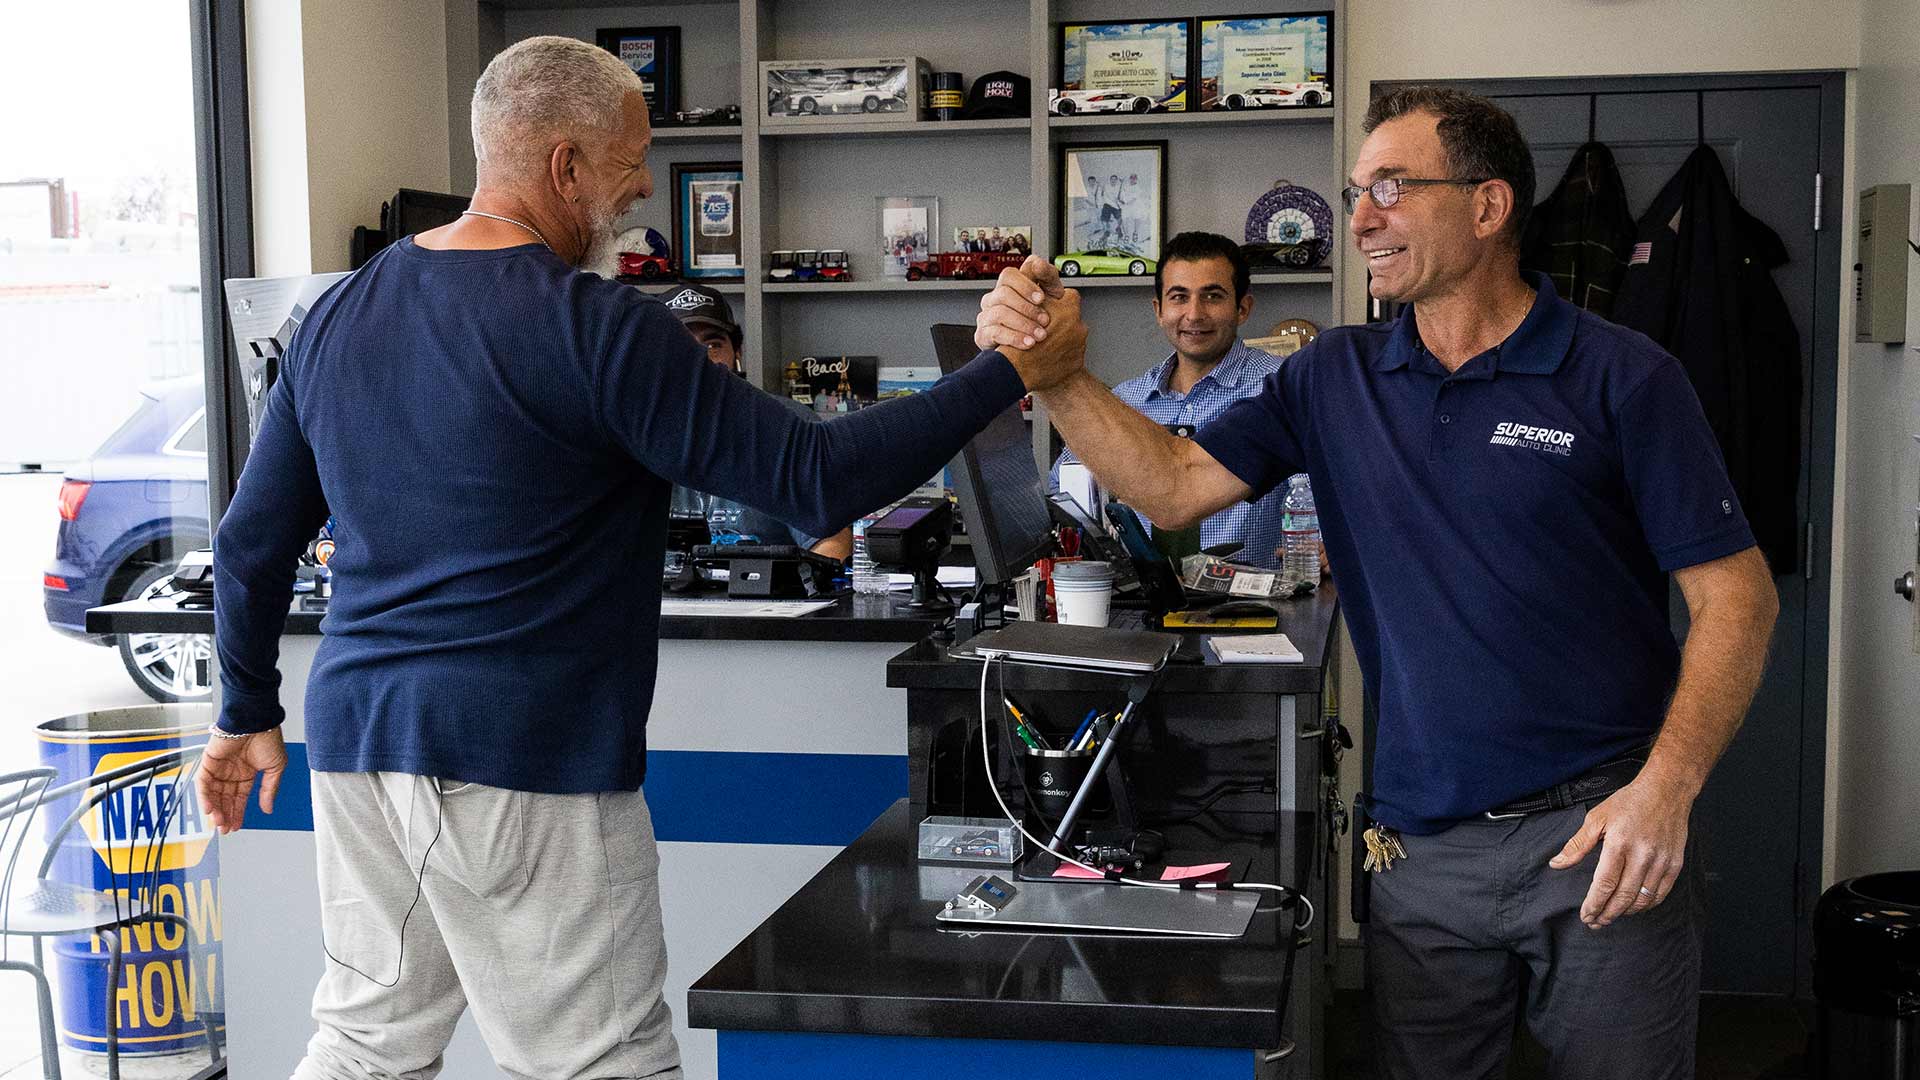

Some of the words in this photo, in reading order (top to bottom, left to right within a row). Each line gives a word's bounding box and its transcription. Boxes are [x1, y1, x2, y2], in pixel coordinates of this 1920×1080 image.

[621, 42, 653, 51] BOSCH
[621, 51, 653, 60] Service
[1121, 49, 1131, 58] 10
[986, 81, 1014, 89] LIQUI
[985, 88, 1014, 98] MOLY
[707, 202, 727, 212] ASE
[672, 298, 686, 307] CAL
[802, 357, 850, 378] Peace
[1494, 422, 1575, 448] SUPERIOR
[1516, 440, 1541, 450] AUTO
[1543, 443, 1572, 457] CLINIC
[102, 783, 203, 842] NAPA
